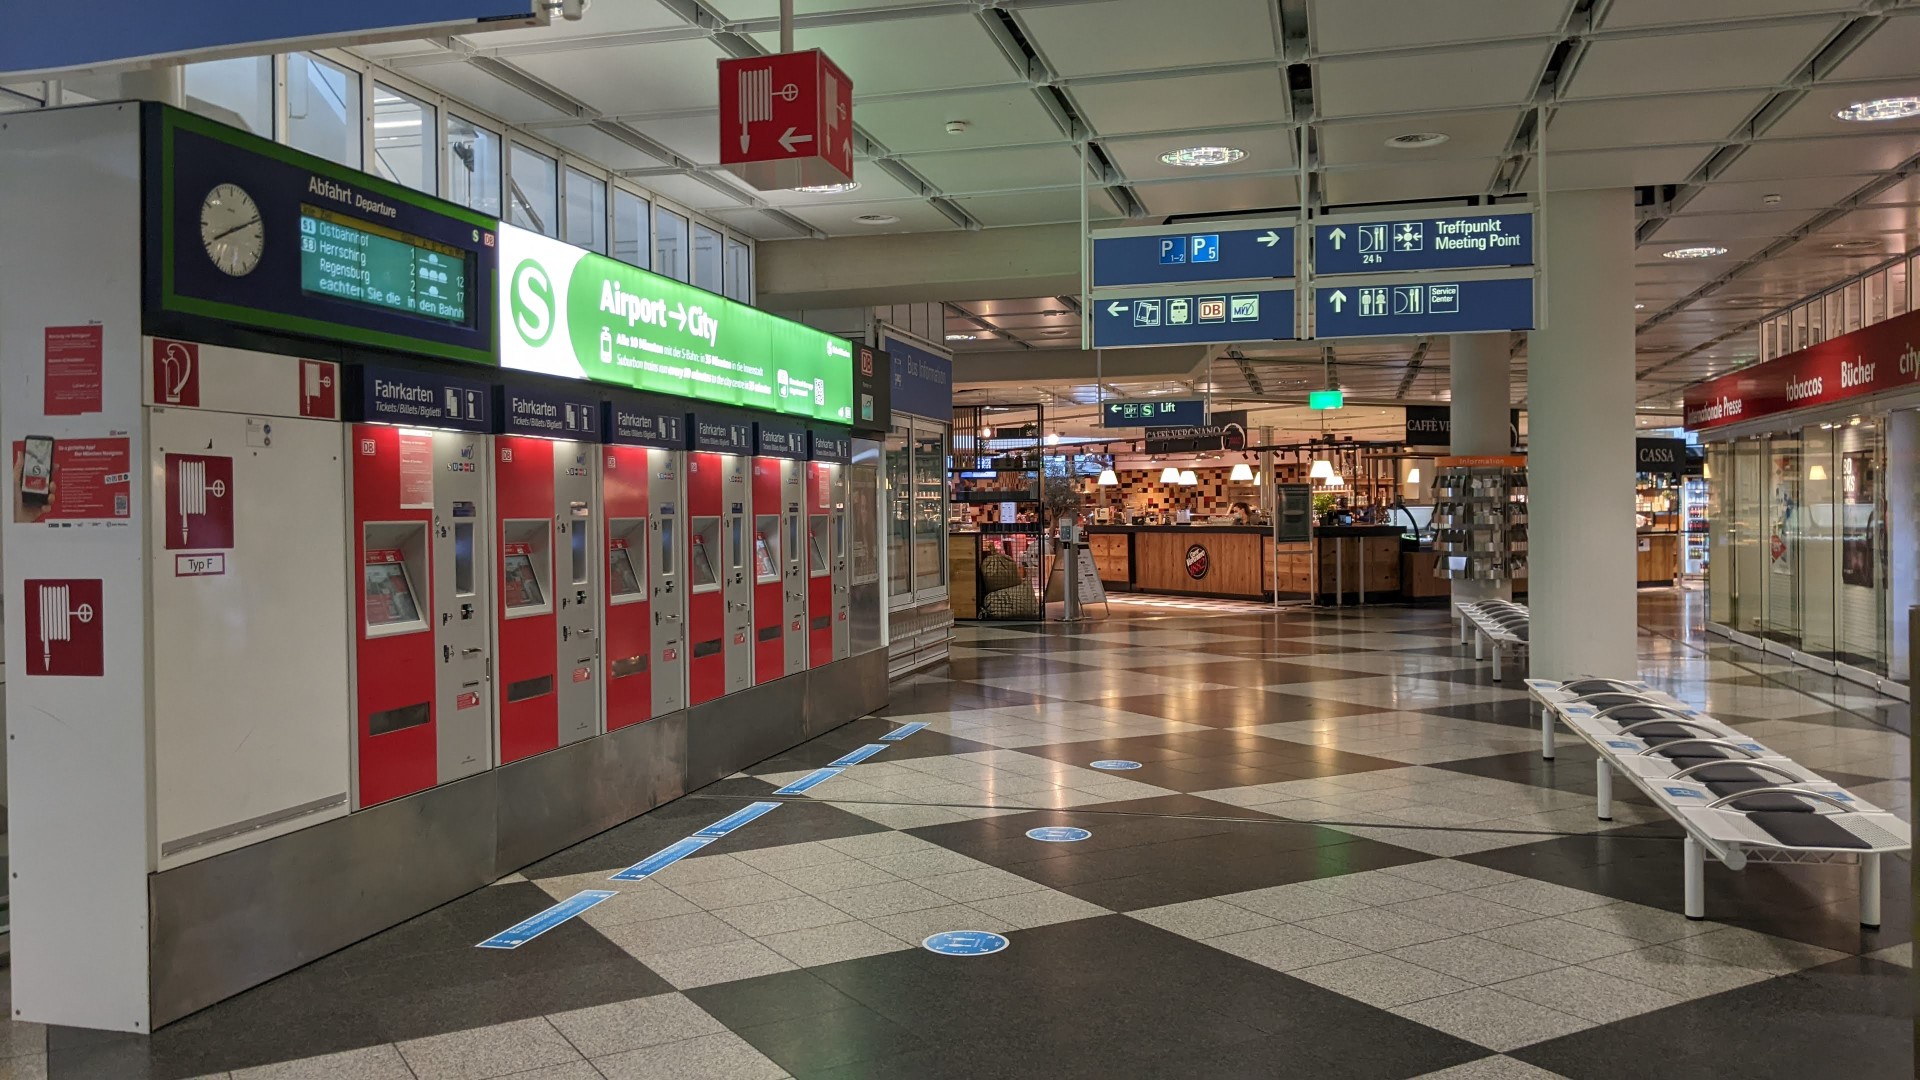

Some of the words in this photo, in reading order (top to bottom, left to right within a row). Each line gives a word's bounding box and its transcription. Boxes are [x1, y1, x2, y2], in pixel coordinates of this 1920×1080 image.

[309, 176, 352, 204] Abfahrt
[355, 194, 397, 219] Departure
[302, 217, 315, 232] S1
[1436, 219, 1501, 235] Treffpunkt
[1162, 240, 1173, 257] P
[1194, 238, 1206, 256] P
[1208, 246, 1216, 259] 5
[1436, 236, 1486, 251] Meeting
[1490, 234, 1521, 247] Point
[320, 241, 367, 266] Herrsching
[456, 276, 464, 288] 12
[1363, 254, 1374, 264] 24
[1376, 254, 1382, 263] h
[320, 258, 370, 285] Regensburg
[367, 287, 383, 302] Sie
[386, 291, 400, 306] die
[419, 298, 436, 314] den
[1432, 288, 1456, 296] Service
[1432, 295, 1454, 303] Center
[518, 266, 550, 340] S
[1202, 303, 1222, 317] DB
[600, 279, 667, 328] Airport
[688, 305, 718, 347] City
[862, 351, 872, 374] DB
[907, 354, 919, 377] Bus
[919, 358, 947, 385] Information
[1841, 355, 1876, 388] Bücher
[375, 379, 434, 403] Fahrkarten
[1786, 374, 1822, 402] tobaccos
[512, 397, 557, 417] Fahrkarten
[1161, 402, 1176, 413] Lift
[1723, 396, 1742, 416] Presse
[618, 412, 652, 429] Fahrkarten
[1407, 418, 1438, 432] CAFFÈ
[699, 422, 727, 437] Fahrkarten
[762, 430, 785, 443] Fahrkarten
[363, 441, 374, 454] DB
[816, 438, 834, 449] Fahrkarten
[1640, 448, 1674, 462] CASSA
[188, 559, 204, 571] Typ
[206, 558, 213, 569] F
